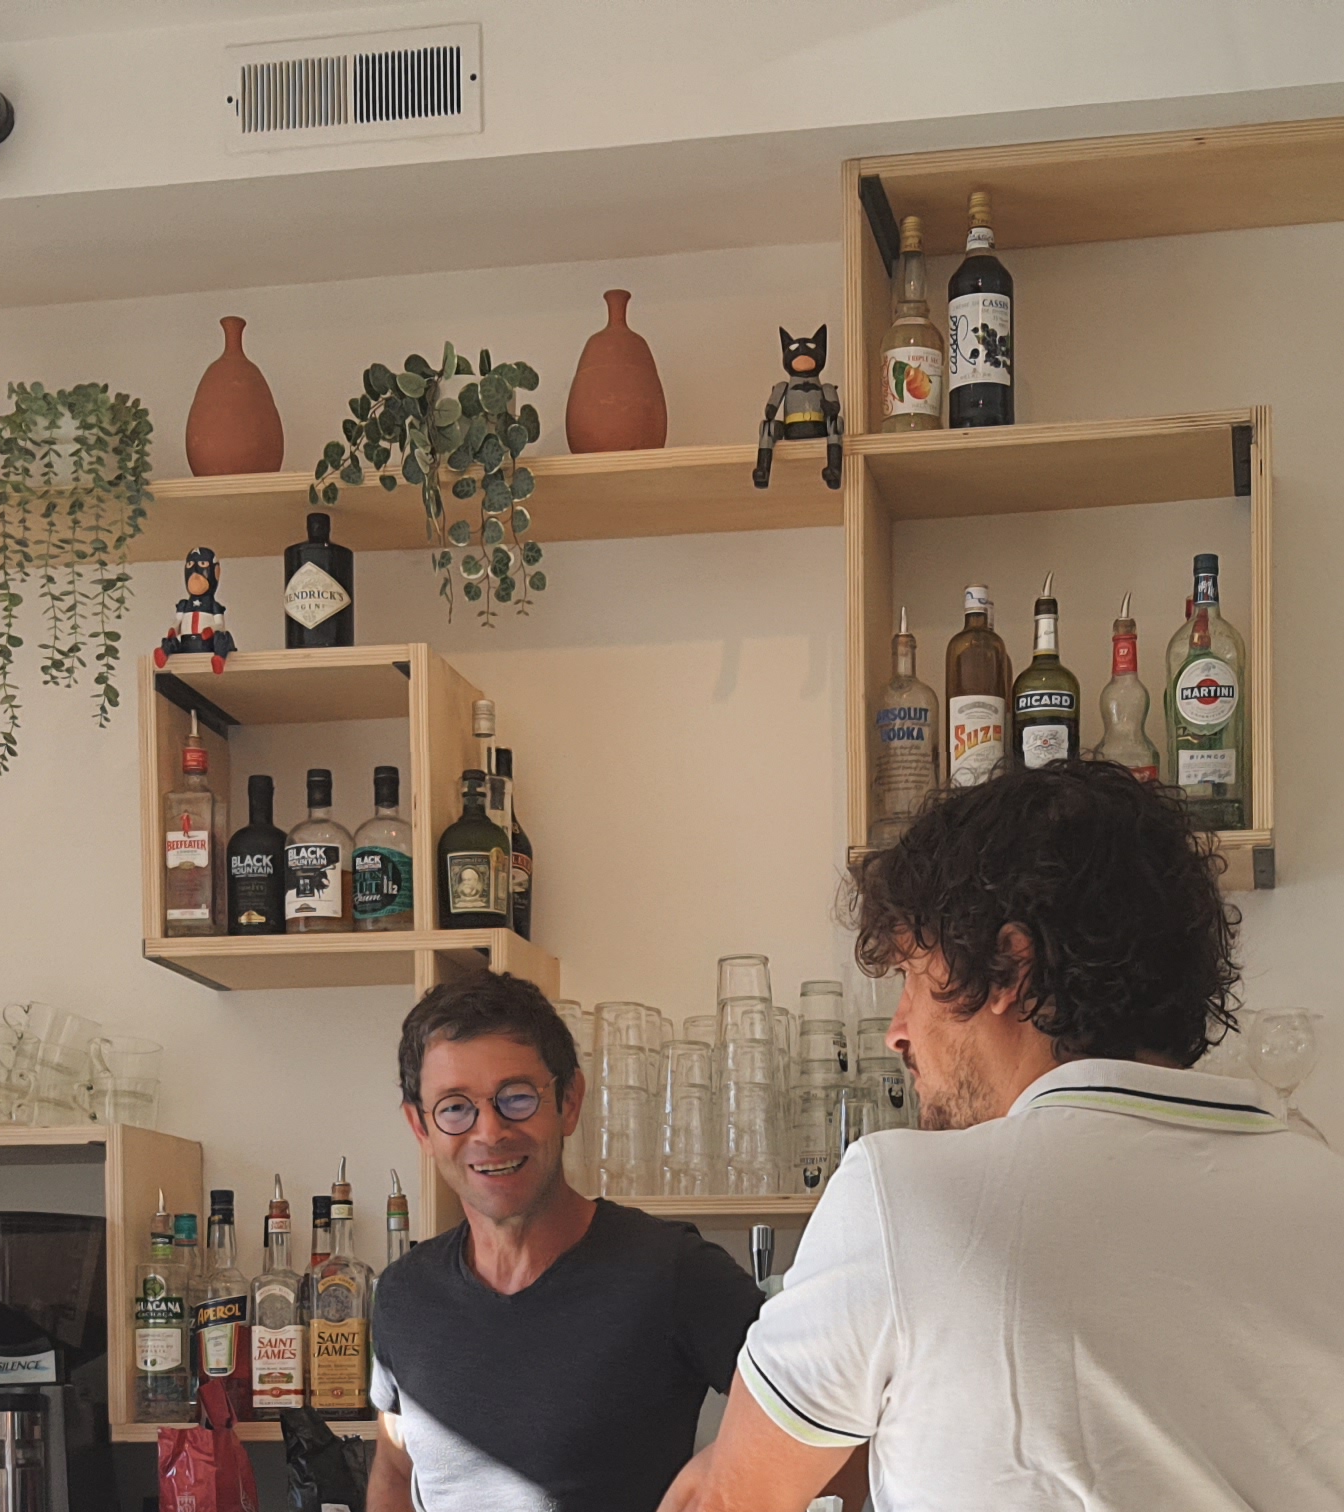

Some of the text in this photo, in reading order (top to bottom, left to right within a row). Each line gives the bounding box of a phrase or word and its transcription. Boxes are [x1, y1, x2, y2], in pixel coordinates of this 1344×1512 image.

[1182, 685, 1234, 699] MARTINI
[1018, 694, 1071, 709] RICARD
[876, 707, 929, 723] ABSOLUT
[881, 727, 925, 742] VODKA
[1189, 753, 1226, 761] BIANCO
[167, 839, 207, 852] BEEFEATER
[288, 846, 327, 860] BLACK
[356, 855, 381, 865] BLACK
[231, 854, 273, 867] BLACK
[231, 866, 273, 876] MOUNTAIN
[197, 1303, 242, 1326] APEROL
[257, 1336, 296, 1349] SAINT
[317, 1331, 359, 1345] SAINT
[254, 1348, 297, 1360] JAMES
[313, 1344, 360, 1358] JAMES
